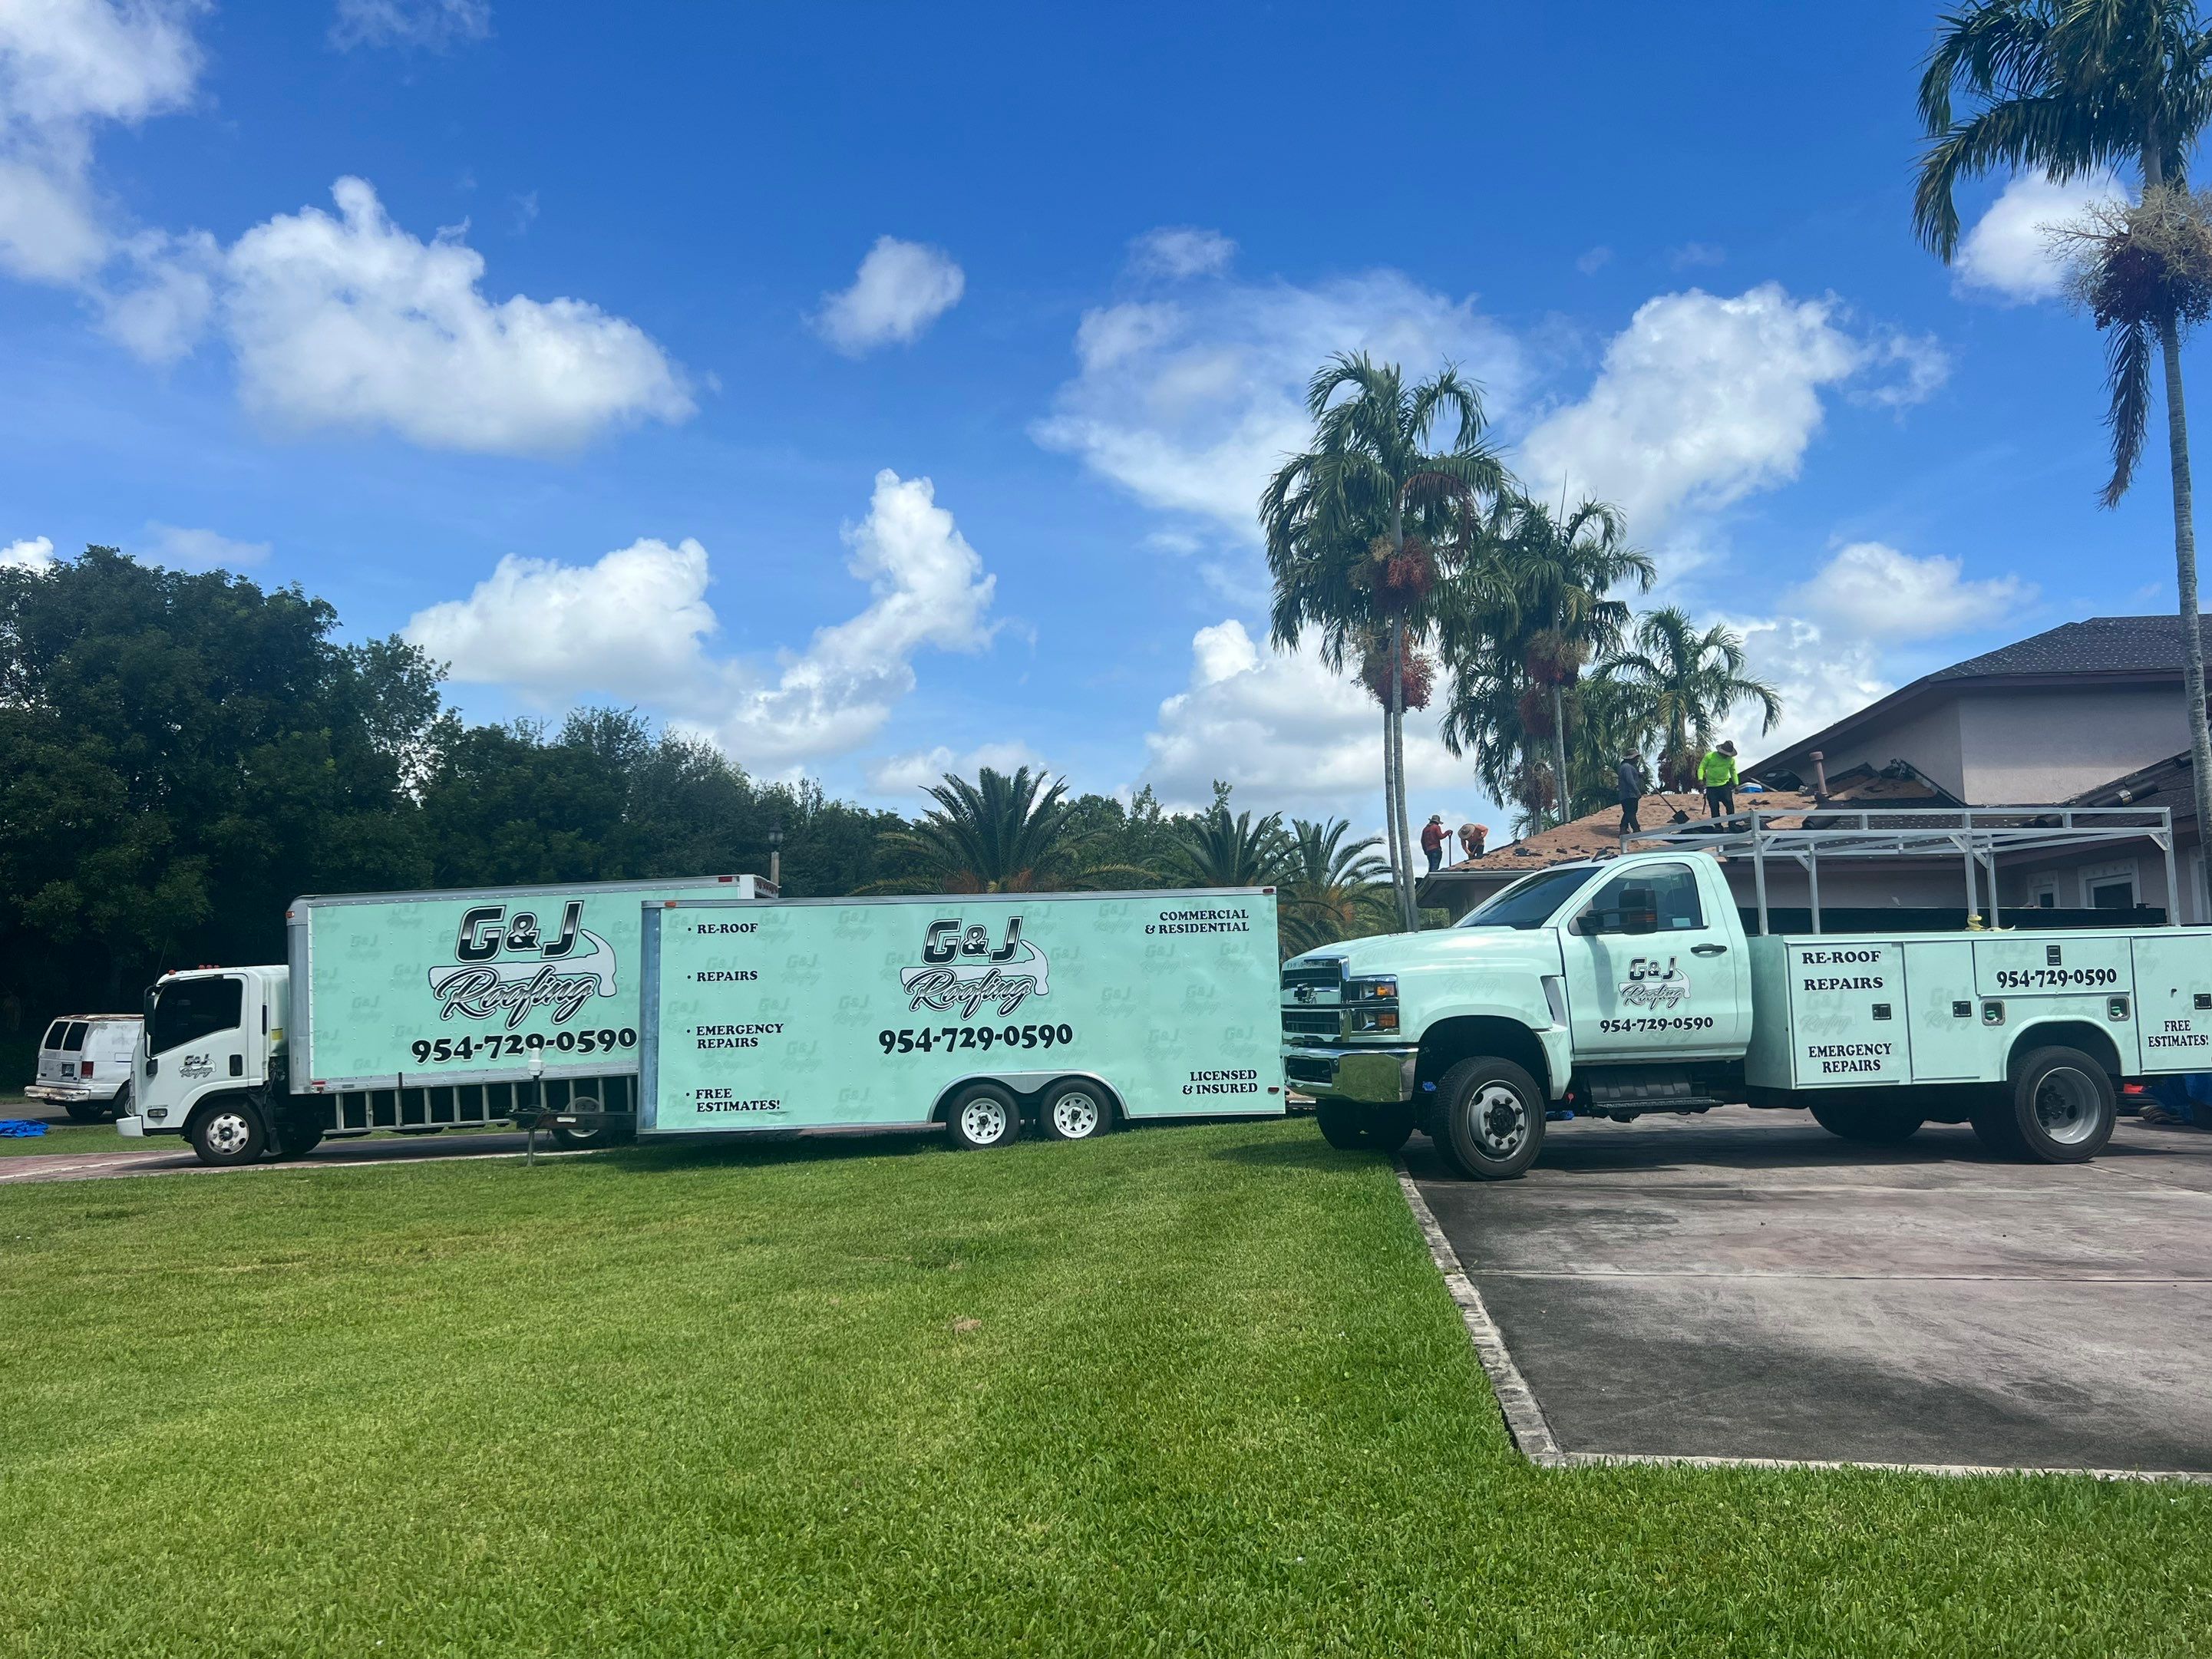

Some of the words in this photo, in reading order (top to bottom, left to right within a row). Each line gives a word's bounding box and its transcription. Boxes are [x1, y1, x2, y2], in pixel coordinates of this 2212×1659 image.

[1159, 909, 1249, 921] COMMERCIAL
[455, 900, 584, 964] G&J
[697, 923, 758, 934] RE-ROOF
[1144, 924, 1155, 934] &
[1159, 922, 1250, 934] RESIDENTIAL
[921, 916, 1024, 965] G&J
[1801, 951, 1881, 964] RE-ROOF
[1628, 956, 1676, 981] G&J
[697, 971, 758, 982] REPAIRS
[1996, 968, 2118, 988] 954-729-0590
[1804, 977, 1884, 991] REPAIRS
[434, 965, 597, 1031] Roofing
[904, 968, 1035, 1021] Roofing
[1621, 982, 1684, 1011] Roofing
[696, 1023, 784, 1036] EMERGENCY
[1600, 1016, 1714, 1034] 954-729-0590
[2164, 1020, 2191, 1032] FREE
[697, 1037, 758, 1049] REPAIRS
[879, 1023, 1073, 1054] 954-729-0590
[2148, 1034, 2210, 1047] ESTIMATES!
[411, 1027, 638, 1064] 954-729-0590
[1808, 1043, 1892, 1057] EMERGENCY
[1822, 1060, 1881, 1073] REPAIRS
[1190, 1070, 1257, 1081] LICENSED
[695, 1088, 732, 1099] FREE
[1182, 1084, 1193, 1094] &
[1196, 1083, 1258, 1094] INSURED
[697, 1100, 781, 1113] ESTIMATES!
